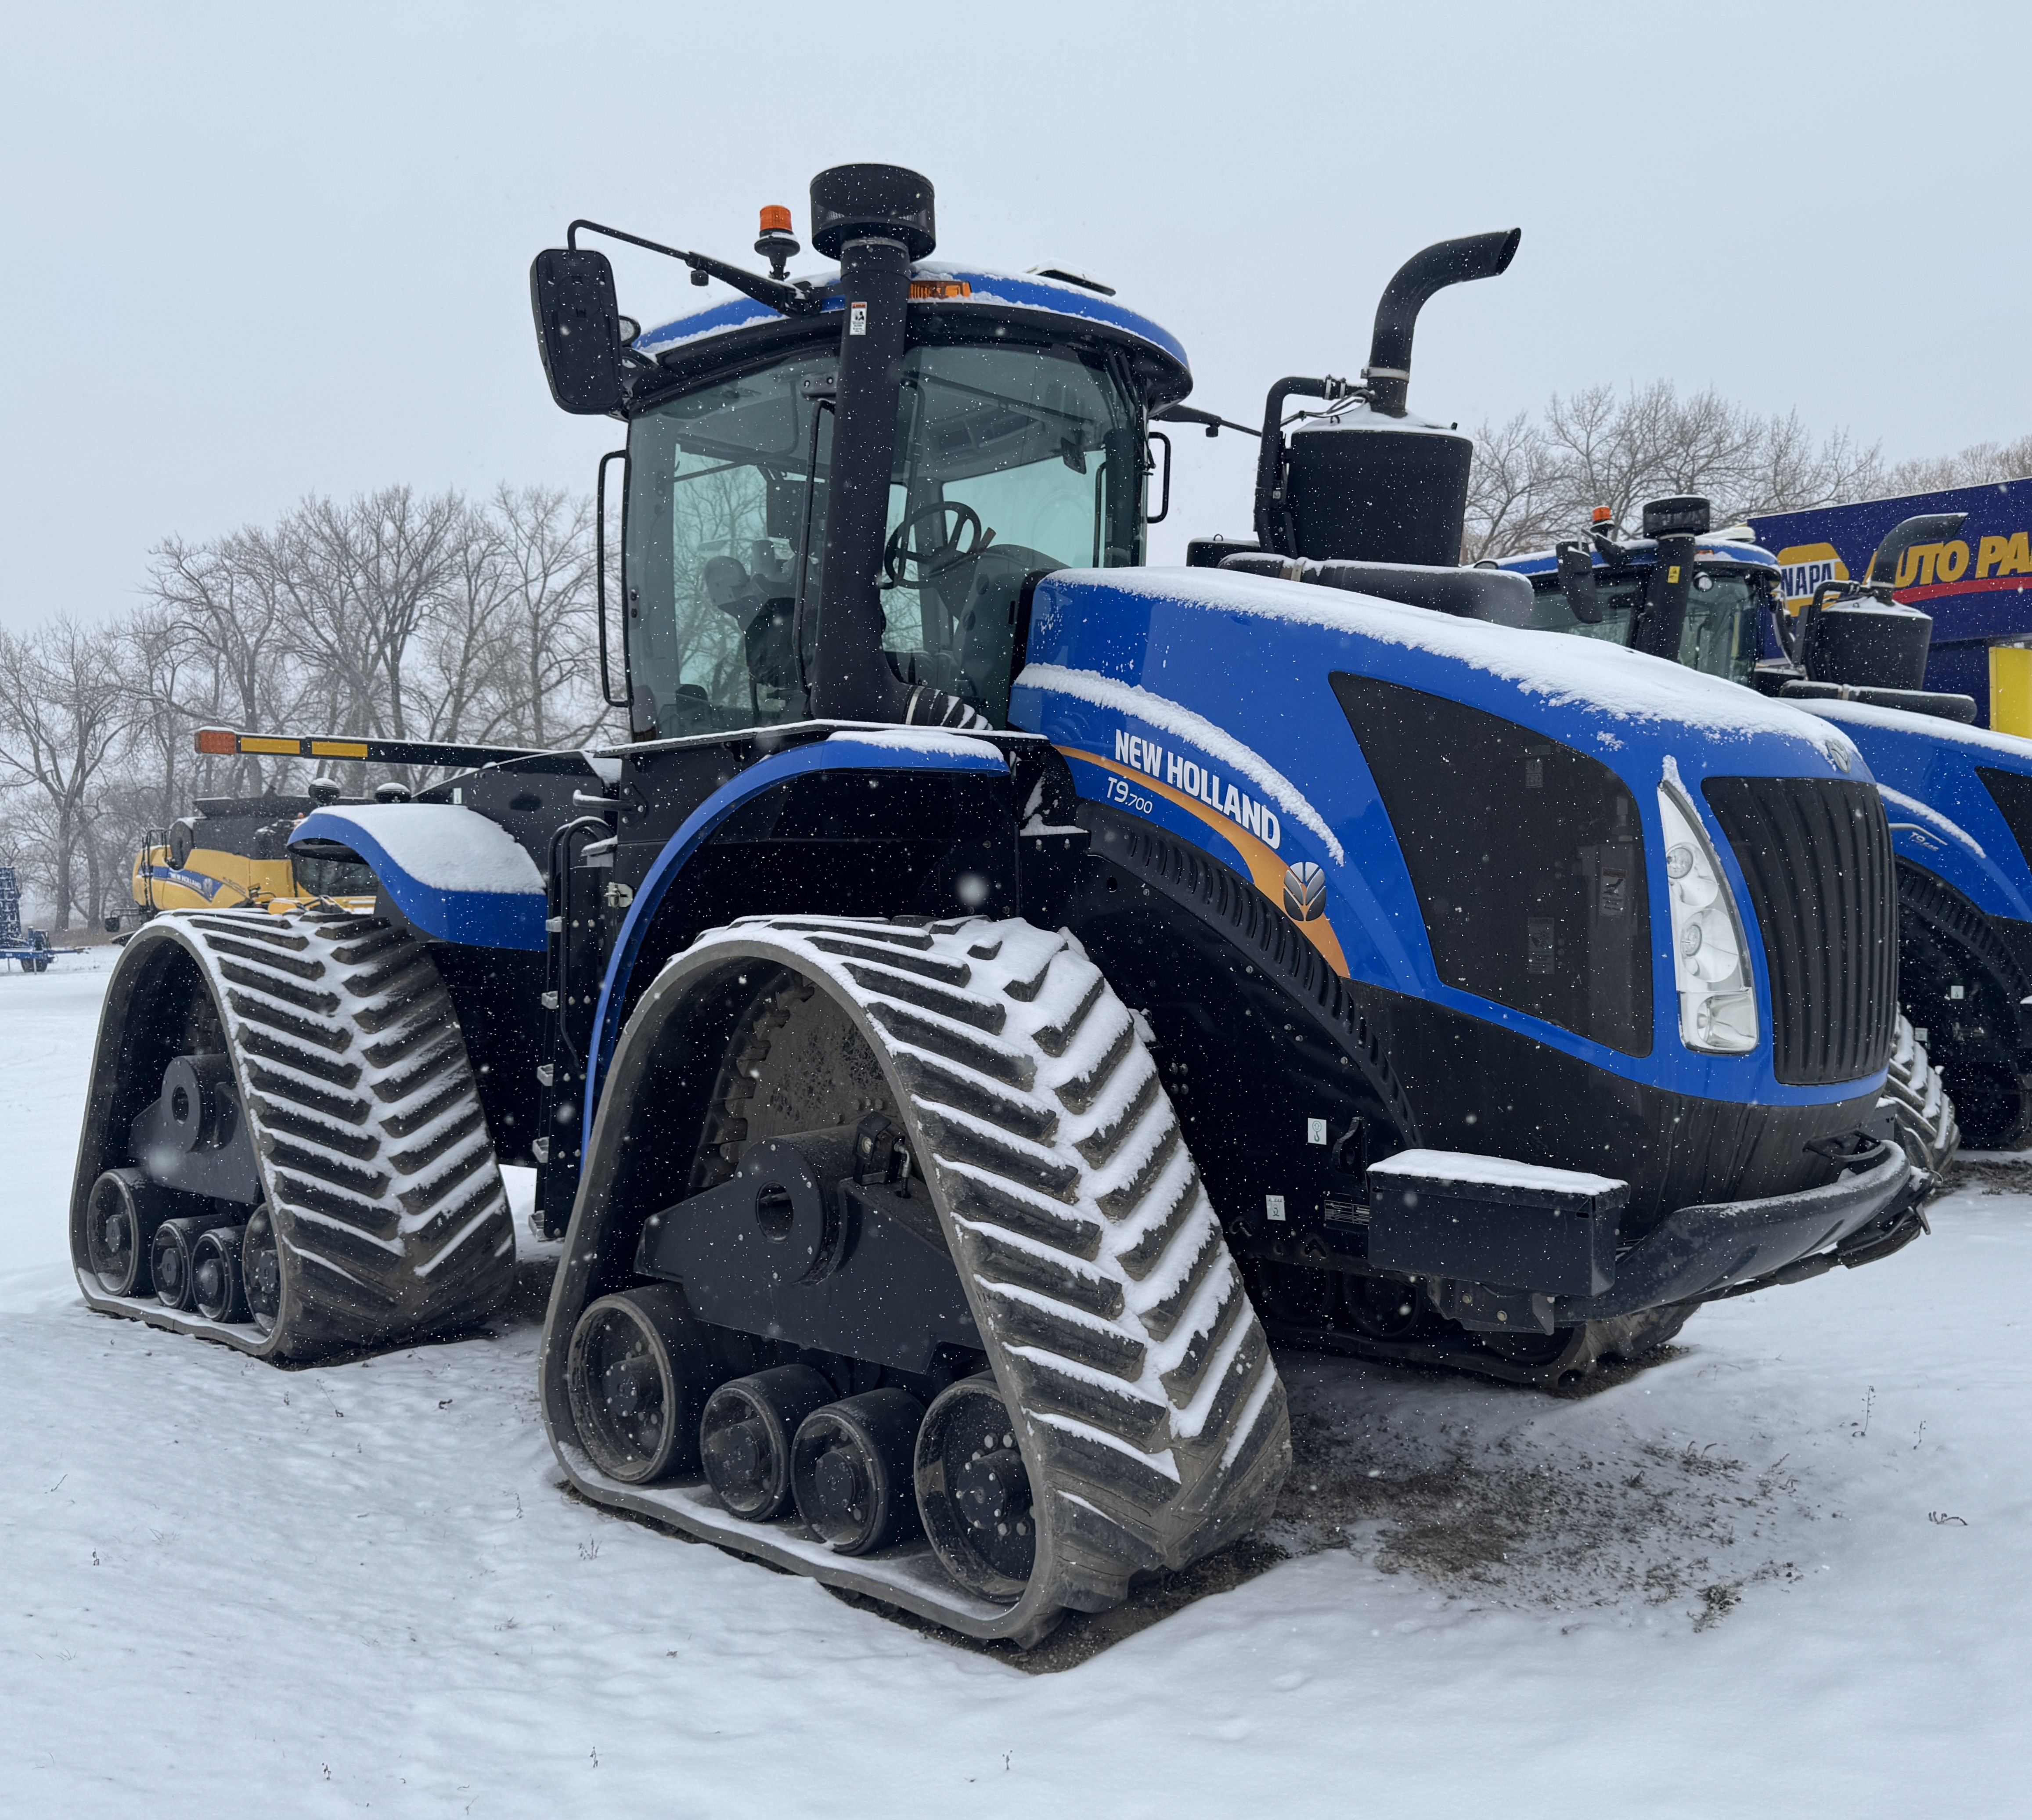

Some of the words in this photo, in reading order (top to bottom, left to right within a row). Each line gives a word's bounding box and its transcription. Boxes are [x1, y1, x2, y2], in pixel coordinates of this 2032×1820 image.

[1781, 563, 1832, 597] NAPA
[1862, 540, 1970, 588] UTO
[1975, 531, 2032, 579] PA
[1106, 777, 1153, 814] T9.700
[1115, 729, 1163, 778] NEW
[1167, 751, 1280, 850] HOLLAND
